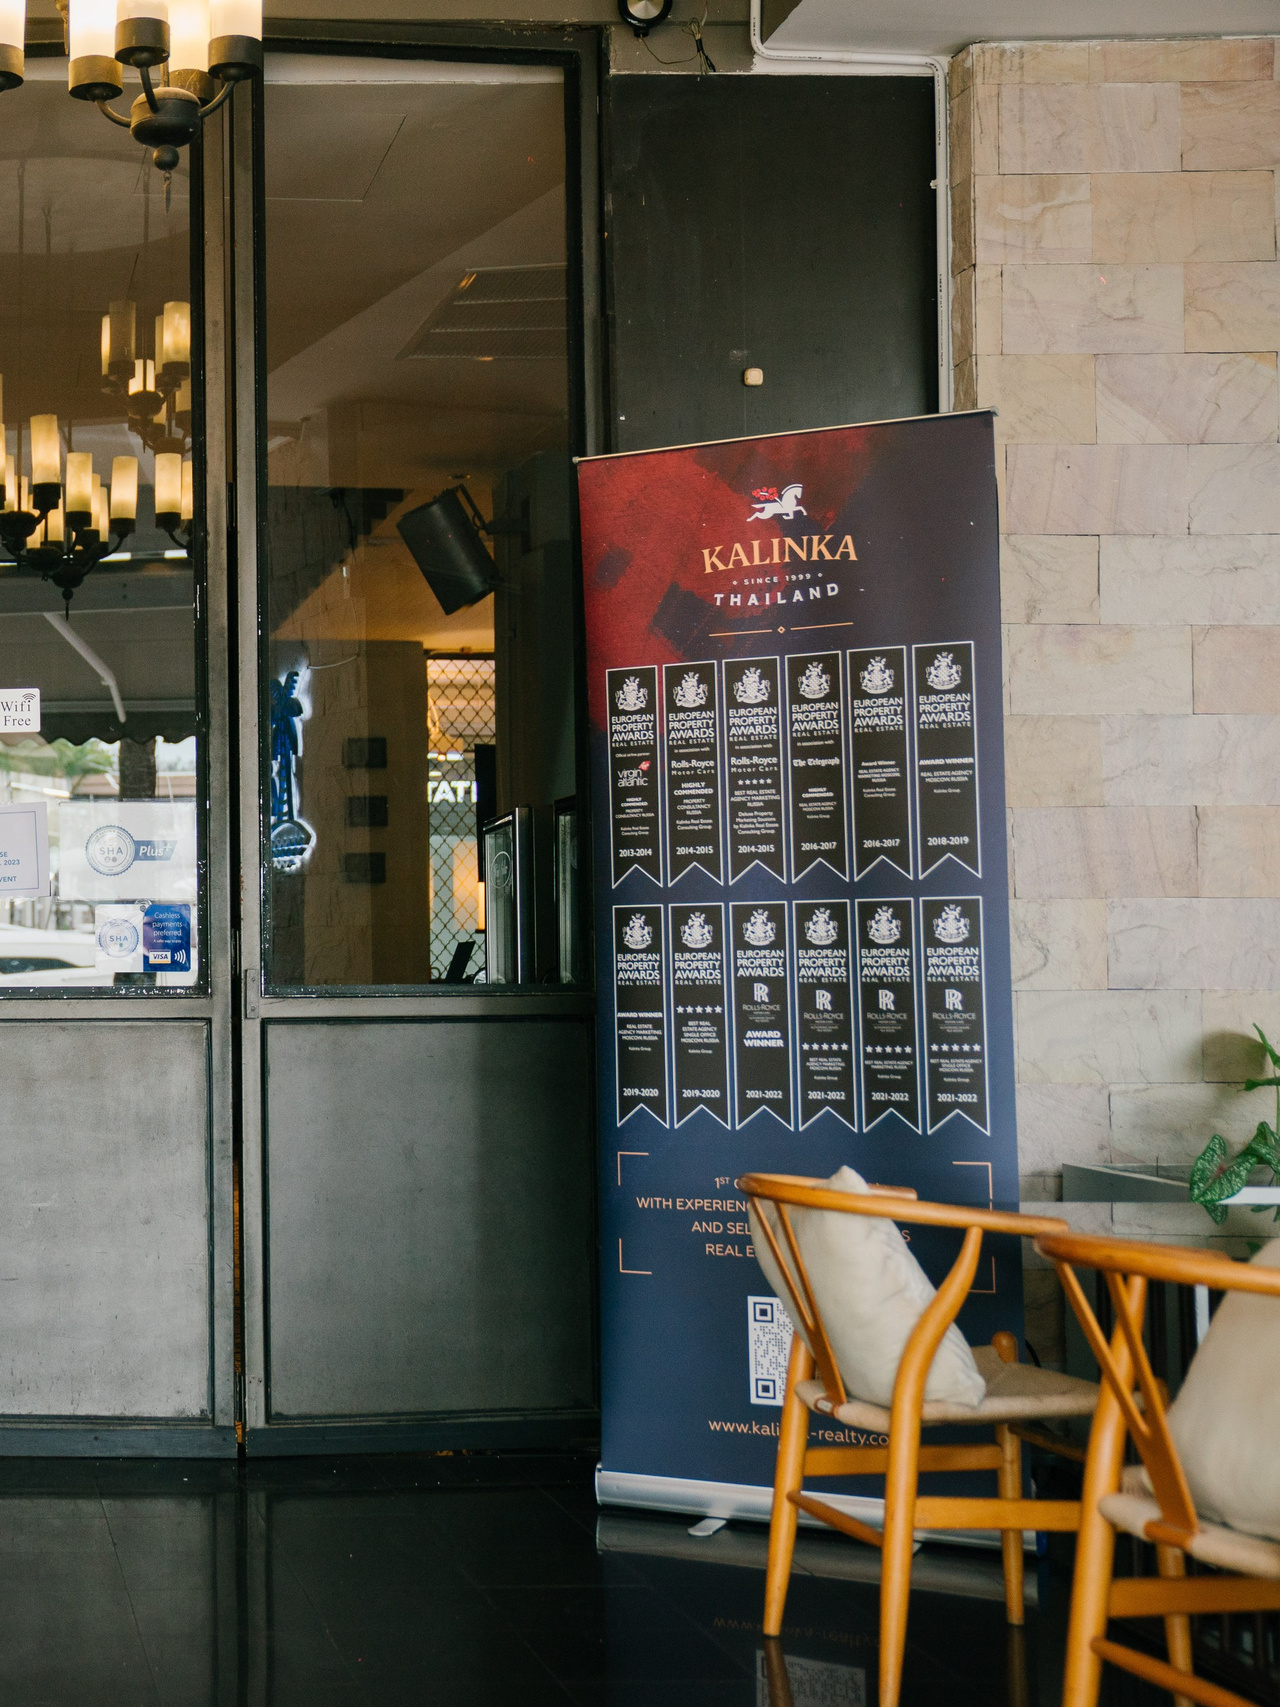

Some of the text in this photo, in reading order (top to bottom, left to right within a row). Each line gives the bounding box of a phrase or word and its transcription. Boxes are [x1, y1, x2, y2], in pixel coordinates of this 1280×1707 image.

[701, 534, 858, 574] KALINKA
[744, 572, 811, 586] SINCE 1999
[714, 582, 840, 606] THAILAND
[919, 693, 970, 704] EUROPEAN
[0, 700, 32, 712] Wifi
[919, 702, 970, 713] PROPERTY
[4, 714, 32, 726] Free
[612, 714, 654, 723] EUROPEAN
[668, 711, 714, 721] EUROPEAN
[920, 712, 971, 723] AWARDS
[612, 722, 653, 732] PROPERTY
[669, 720, 714, 729] PROPERTY
[612, 731, 654, 741] AWARDS
[669, 728, 714, 739] AWARDS
[671, 760, 714, 770] Rolls-Royce
[731, 756, 777, 767] Rolls-Royce
[618, 768, 642, 779] virgin
[618, 777, 648, 787] atlantic
[863, 839, 900, 848] 2016-2017
[928, 836, 969, 846] 2018-2019
[676, 846, 713, 855] 2014-2015
[738, 844, 775, 853] 2014-2015
[801, 842, 837, 851] 2016-2017
[619, 849, 652, 857] 2013-2014
[737, 950, 784, 959] EUROPEAN
[927, 947, 979, 957] EUROPEAN
[737, 958, 783, 967] PROPERTY
[928, 956, 978, 966] PROPERTY
[737, 967, 784, 977] AWARDS
[927, 966, 979, 976] AWARDS
[743, 1039, 784, 1047] WINNER
[623, 1088, 659, 1097] 2019-2020
[682, 1089, 720, 1098] 2019-2020
[746, 1091, 782, 1099] 2021-2022
[808, 1091, 845, 1100] 2021-2022
[872, 1092, 909, 1101] 2021-2022
[937, 1093, 978, 1102] 2021-2022
[714, 1176, 730, 1189] 1ST
[636, 1196, 748, 1212] WITH EXPERIEN
[692, 1221, 723, 1234] AND
[706, 1244, 742, 1256] REAL
